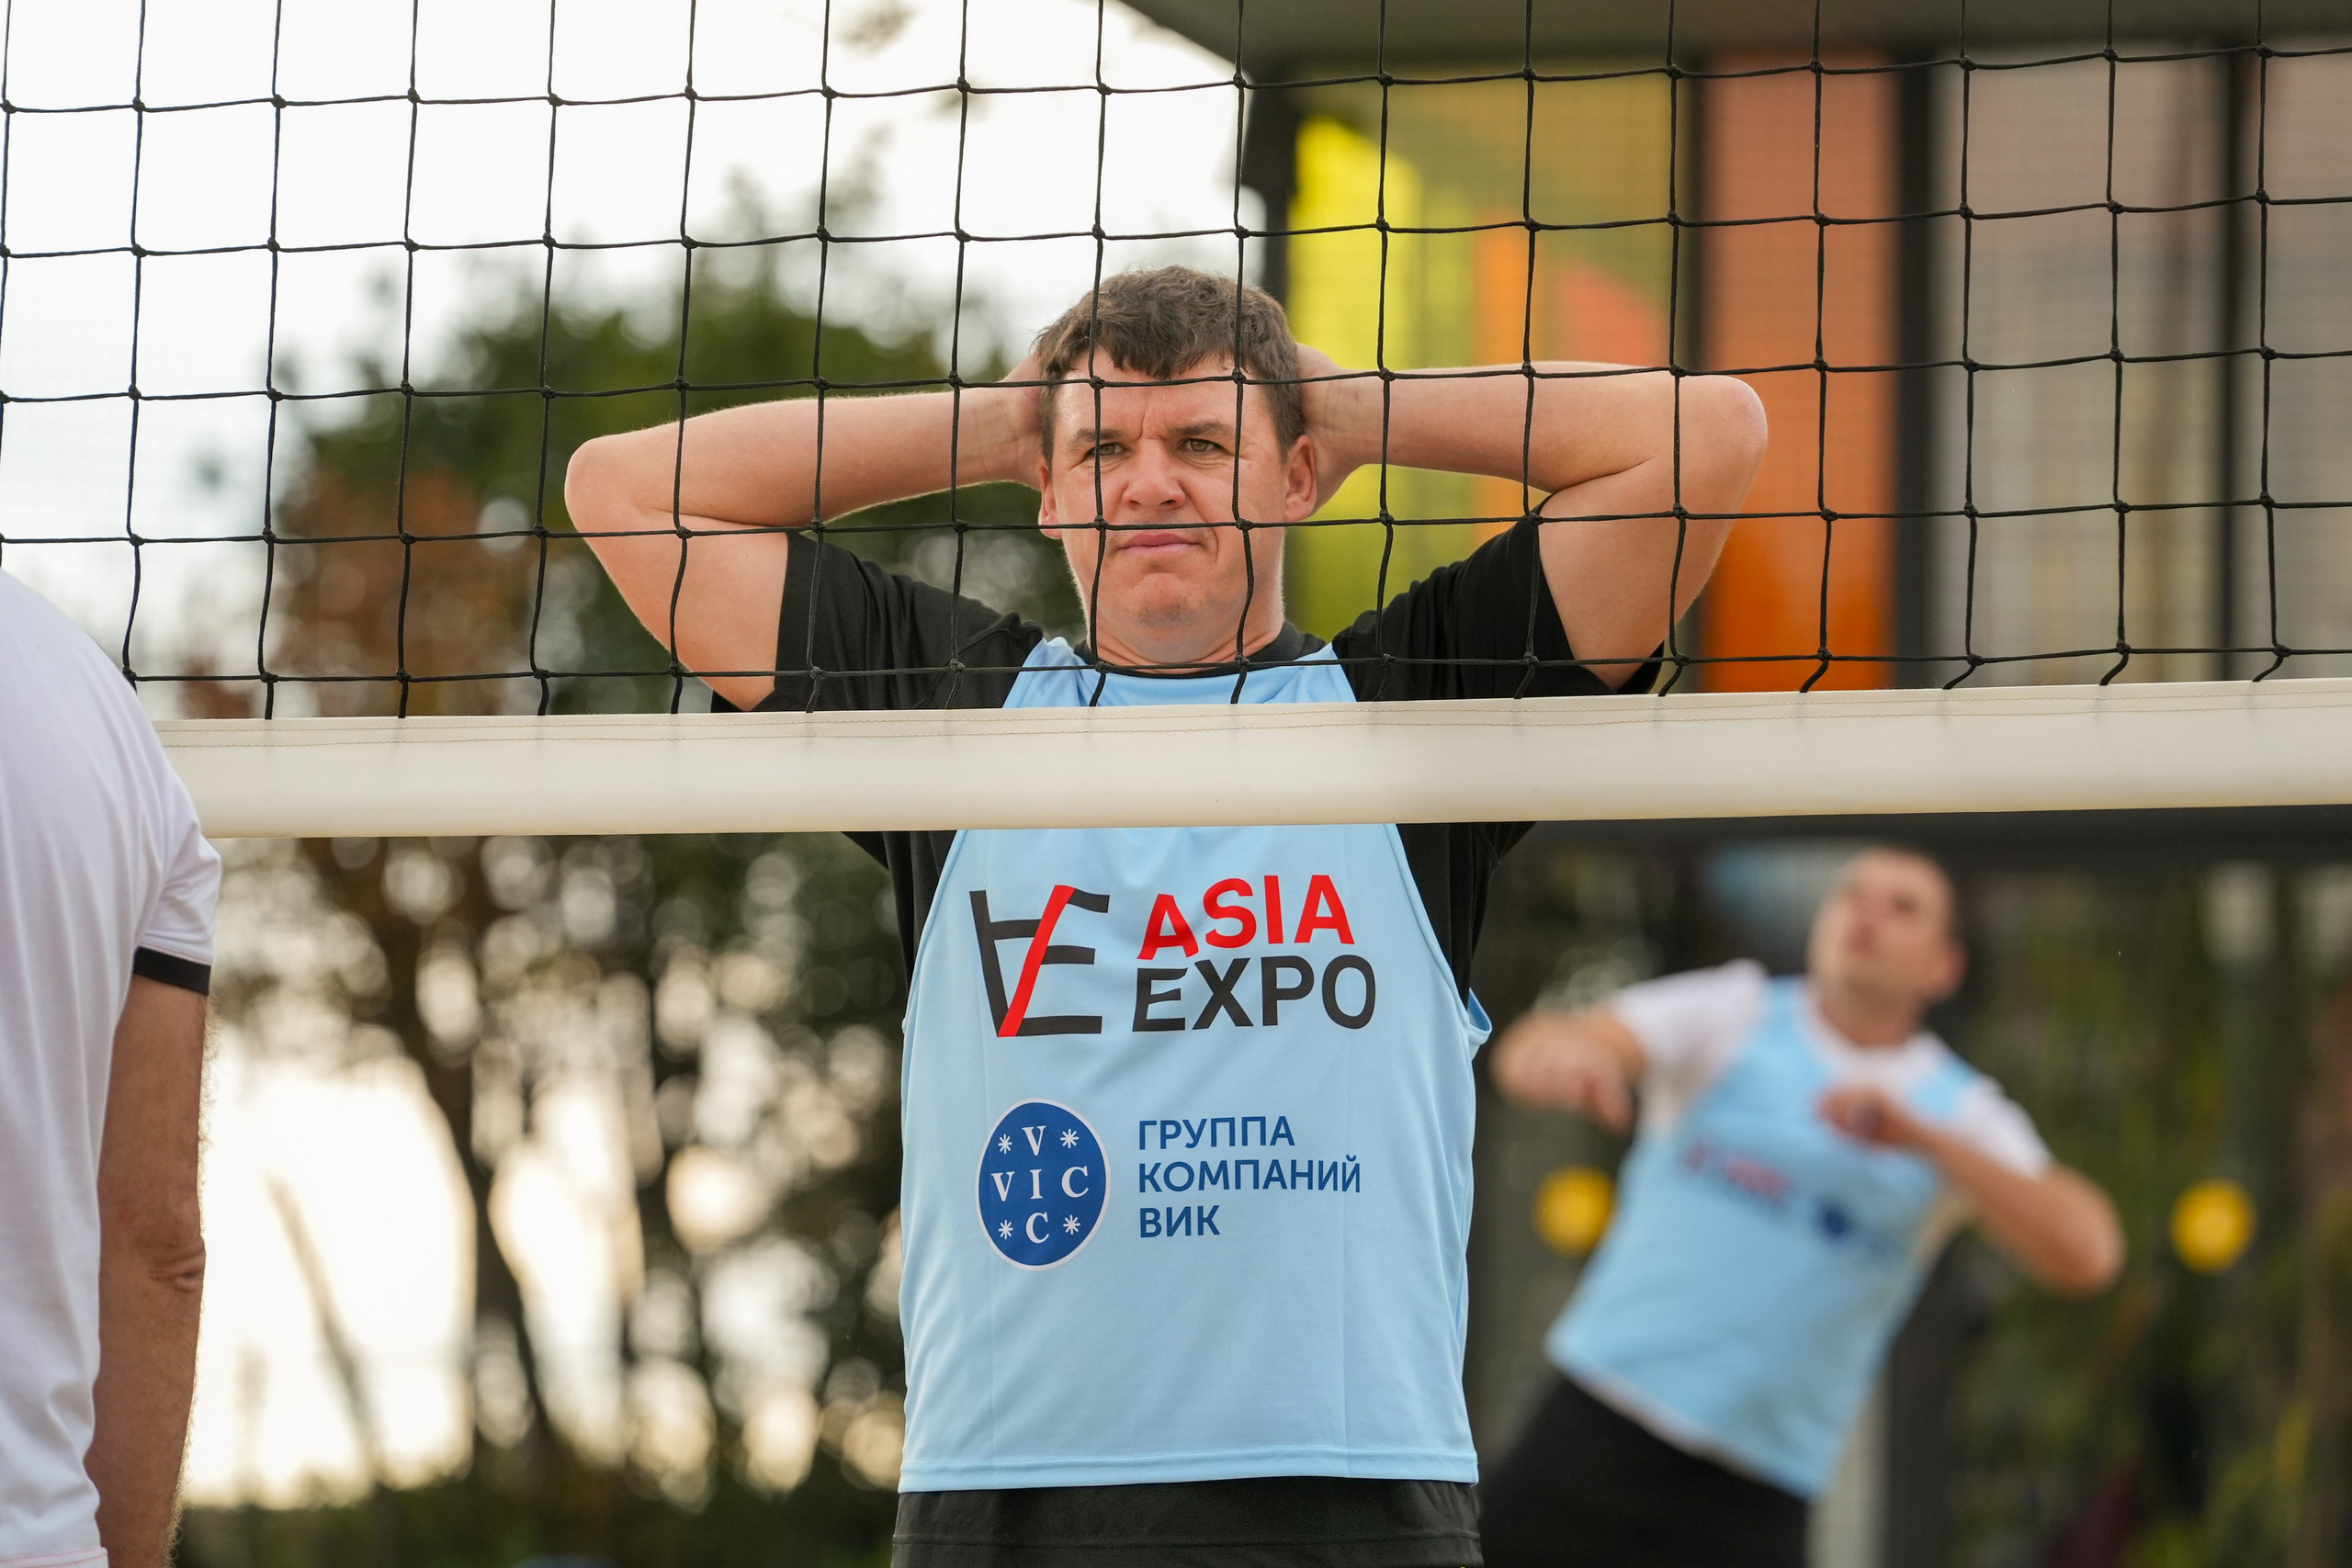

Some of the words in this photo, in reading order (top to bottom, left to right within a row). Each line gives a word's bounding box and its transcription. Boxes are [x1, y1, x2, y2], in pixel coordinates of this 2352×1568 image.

[1136, 874, 1355, 960] ASIA
[1132, 954, 1376, 1032] EXPO
[1138, 1115, 1295, 1151] ГРУППА
[1138, 1155, 1361, 1193] КОМПАНИЙ
[1139, 1205, 1220, 1238] ВИК
